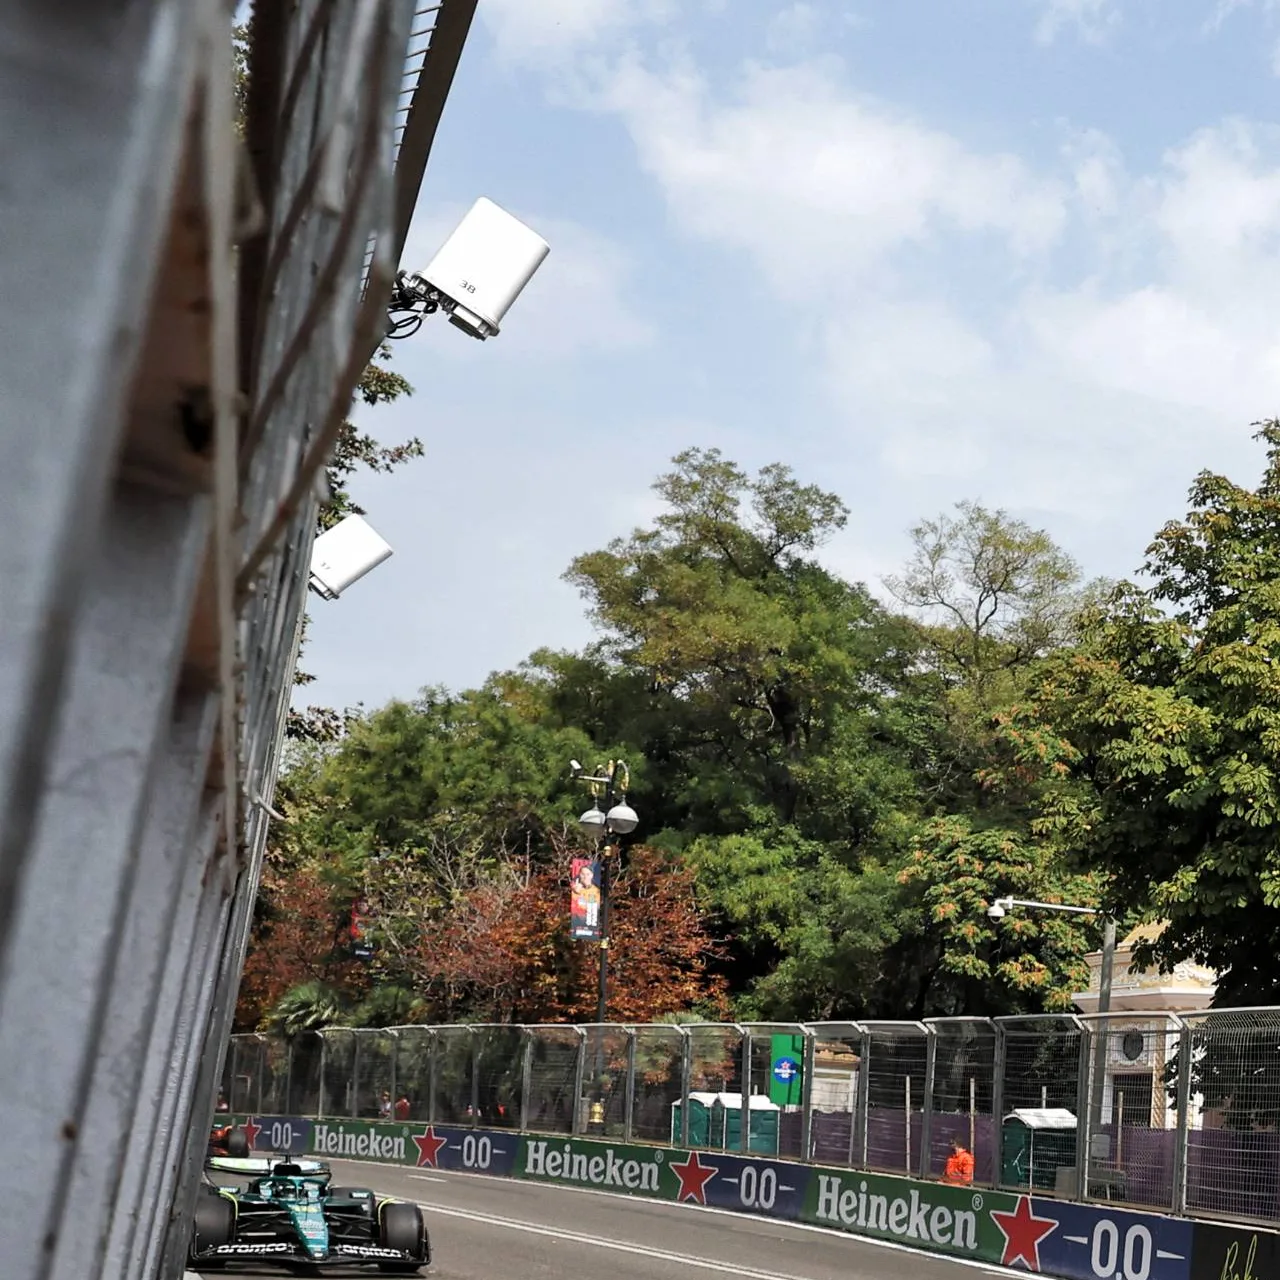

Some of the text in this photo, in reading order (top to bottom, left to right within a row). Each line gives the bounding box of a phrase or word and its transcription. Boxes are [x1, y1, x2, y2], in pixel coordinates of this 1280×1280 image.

[460, 281, 476, 294] 38
[313, 1125, 406, 1159] Heineken
[525, 1140, 660, 1192] Heineken
[740, 1166, 777, 1209] 0.0
[816, 1174, 978, 1250] Heineken
[217, 1243, 287, 1254] aramco
[342, 1244, 402, 1257] aramco
